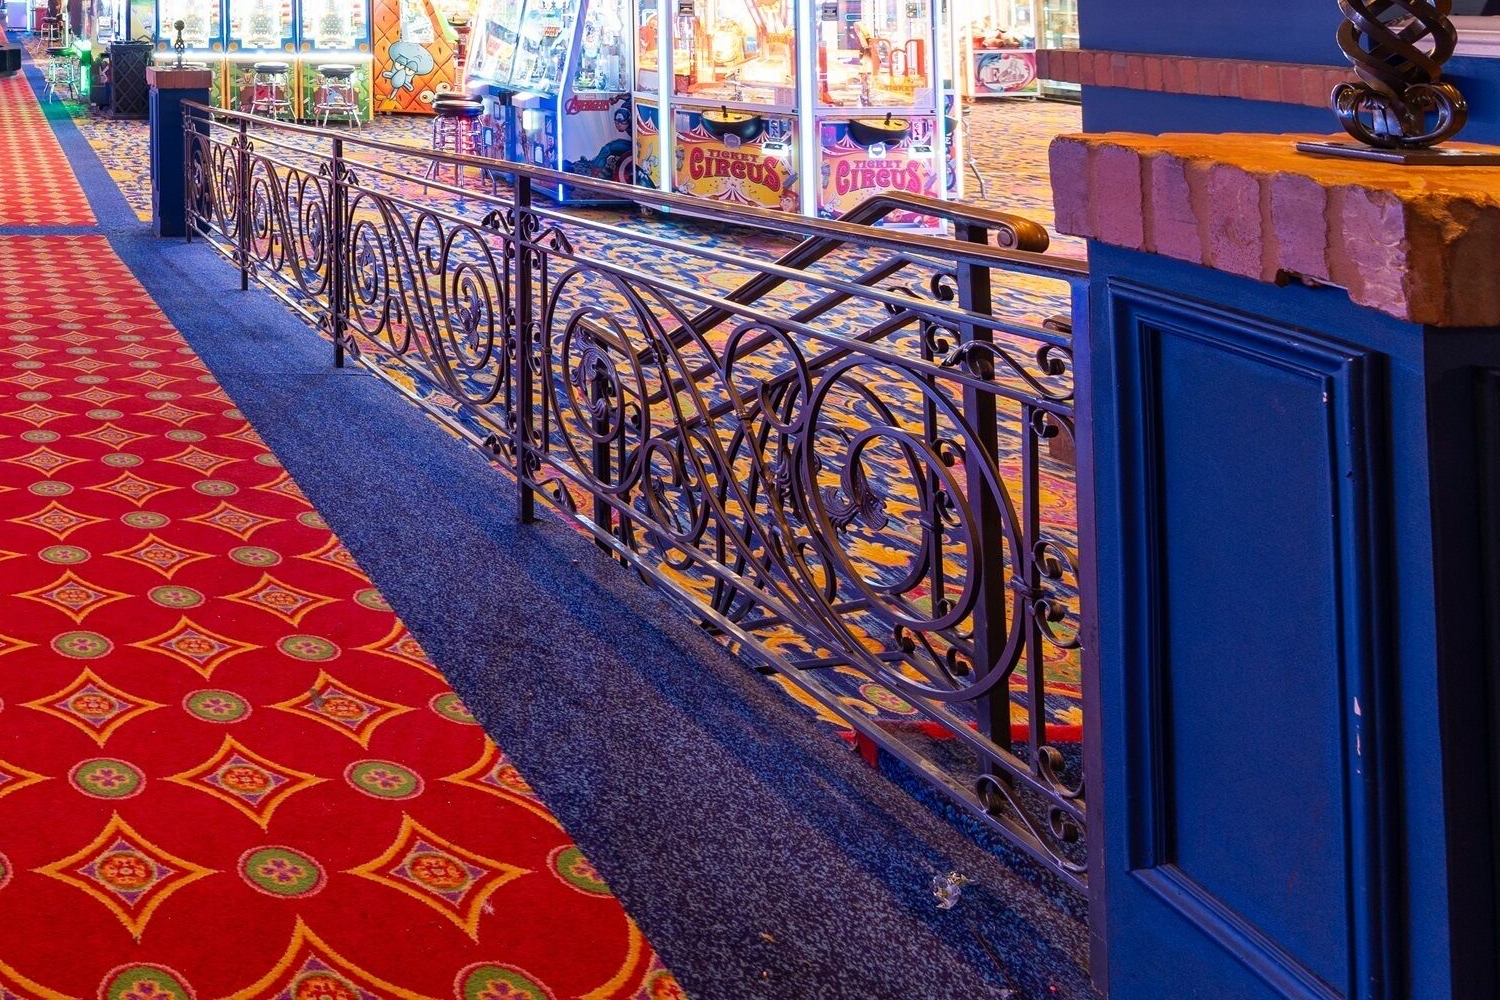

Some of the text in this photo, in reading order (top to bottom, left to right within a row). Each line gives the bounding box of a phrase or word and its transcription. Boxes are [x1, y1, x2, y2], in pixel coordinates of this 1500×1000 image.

[708, 148, 759, 162] TICKET
[853, 160, 903, 169] TICKET
[689, 146, 781, 192] CIRCUS
[835, 159, 922, 196] CIRCUS
